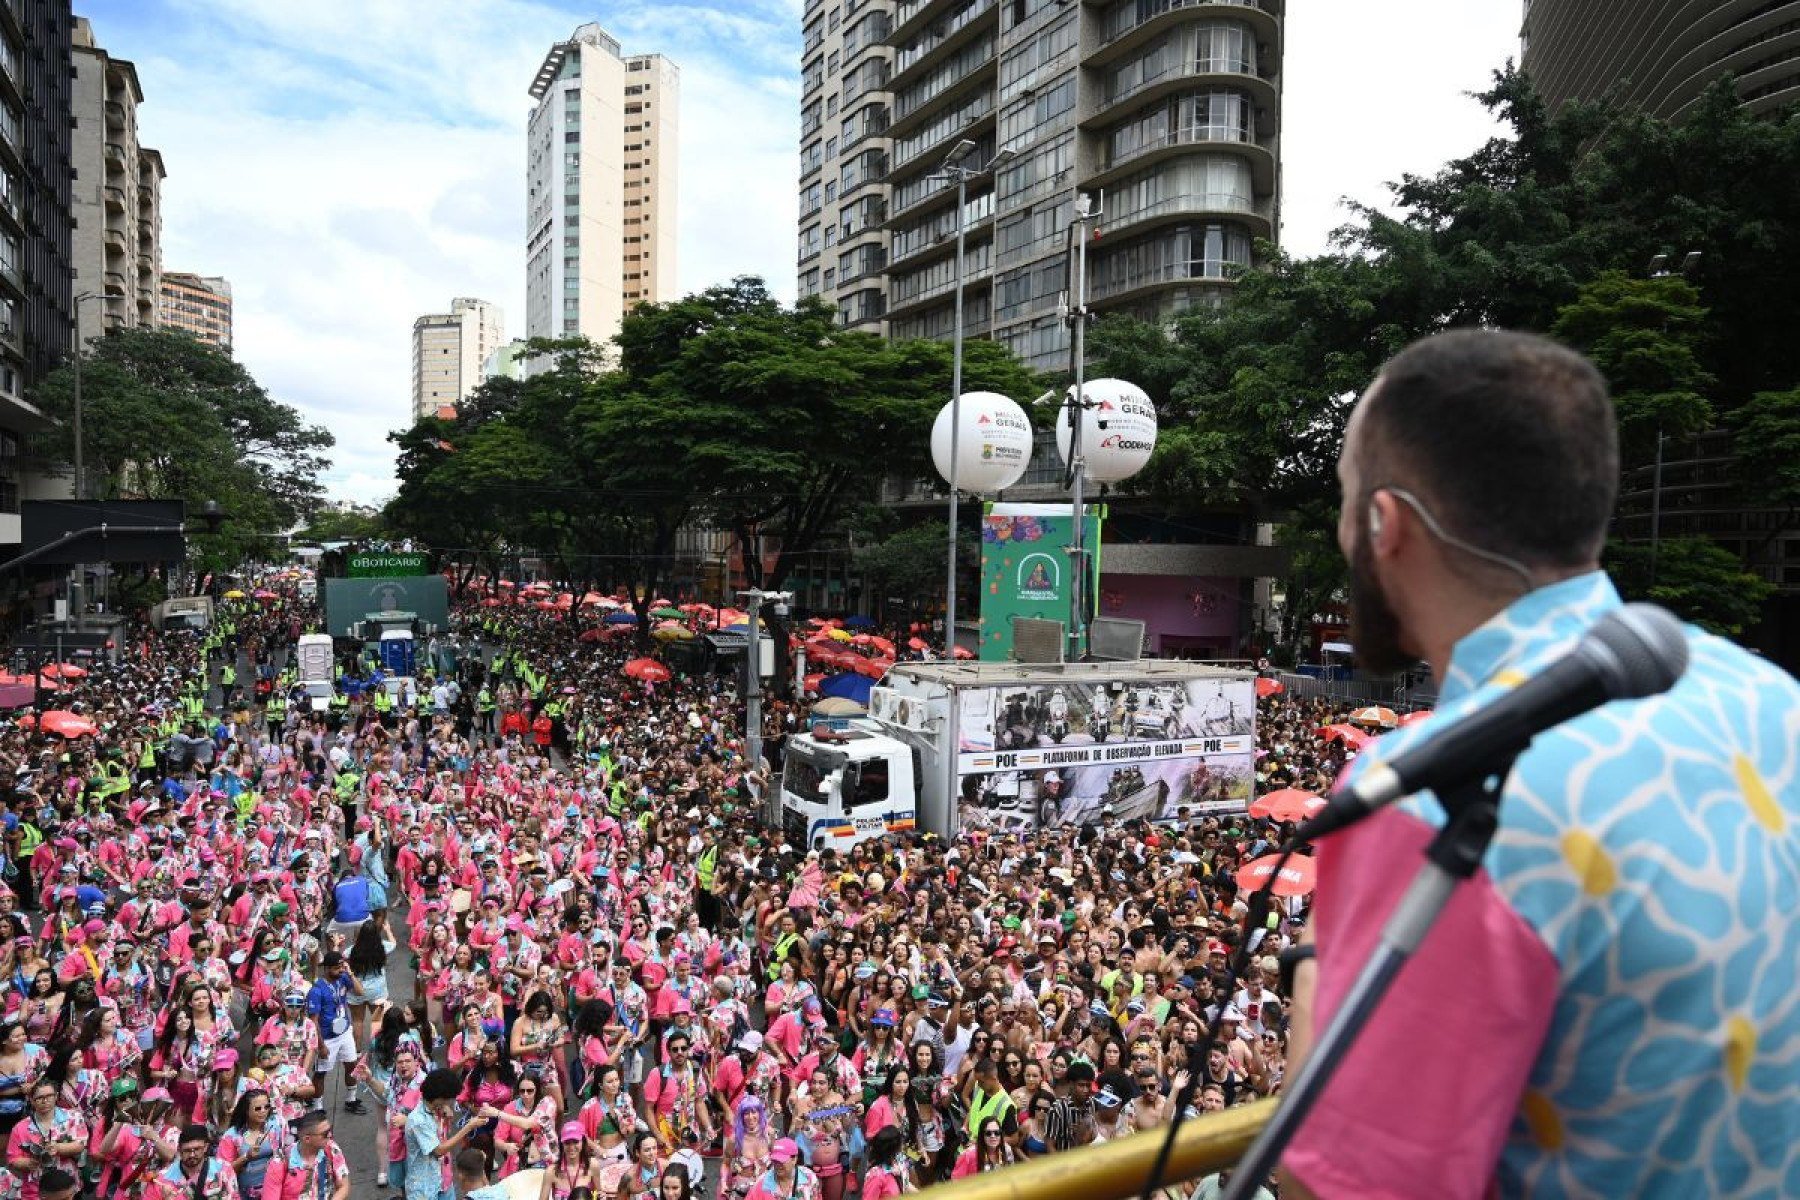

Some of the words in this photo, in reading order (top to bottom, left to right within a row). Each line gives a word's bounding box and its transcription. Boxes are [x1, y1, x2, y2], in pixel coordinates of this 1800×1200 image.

[995, 754, 1018, 768] POE
[1043, 750, 1089, 764] PLATAFORMA
[1093, 749, 1102, 760] DE
[1154, 743, 1183, 756] ELEVADA
[1204, 740, 1222, 752] POE
